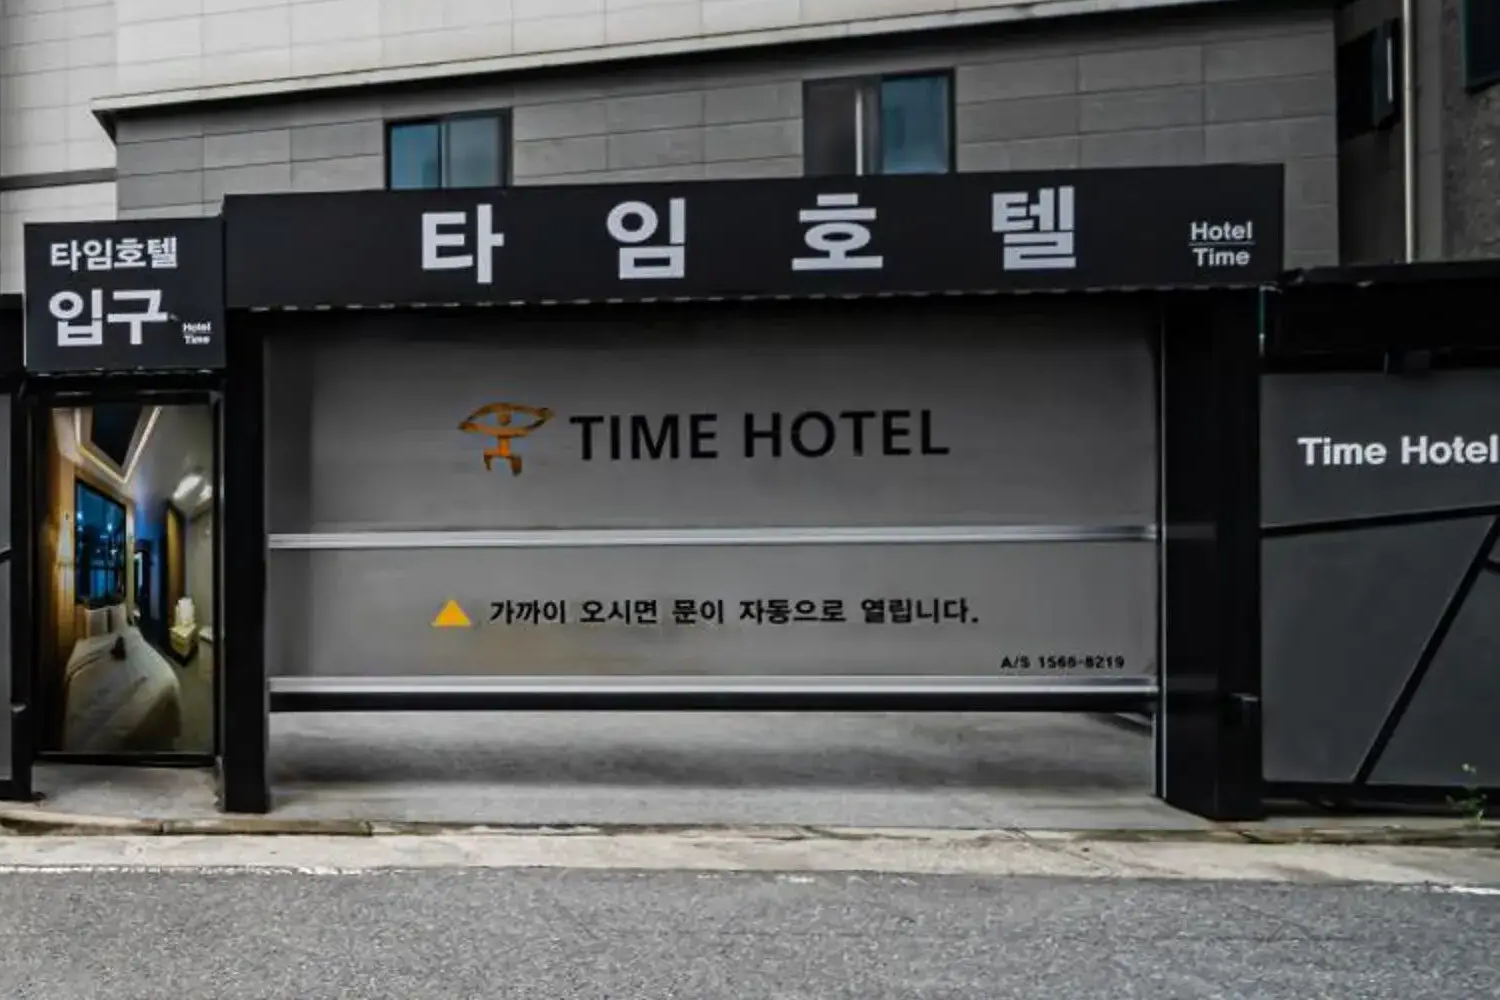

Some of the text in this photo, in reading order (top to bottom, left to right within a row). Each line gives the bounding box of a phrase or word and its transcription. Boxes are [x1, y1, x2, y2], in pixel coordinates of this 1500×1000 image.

[1190, 221, 1253, 241] Hotel
[50, 236, 178, 271] 타임호텔
[1191, 247, 1251, 267] Time
[49, 288, 169, 347] 입구
[569, 409, 950, 461] TIME HOTEL
[1297, 434, 1499, 466] Time Hotel
[489, 597, 979, 625] 가까이 오시면 문이 자동으로 열립니다.
[1000, 655, 1031, 669] A/S
